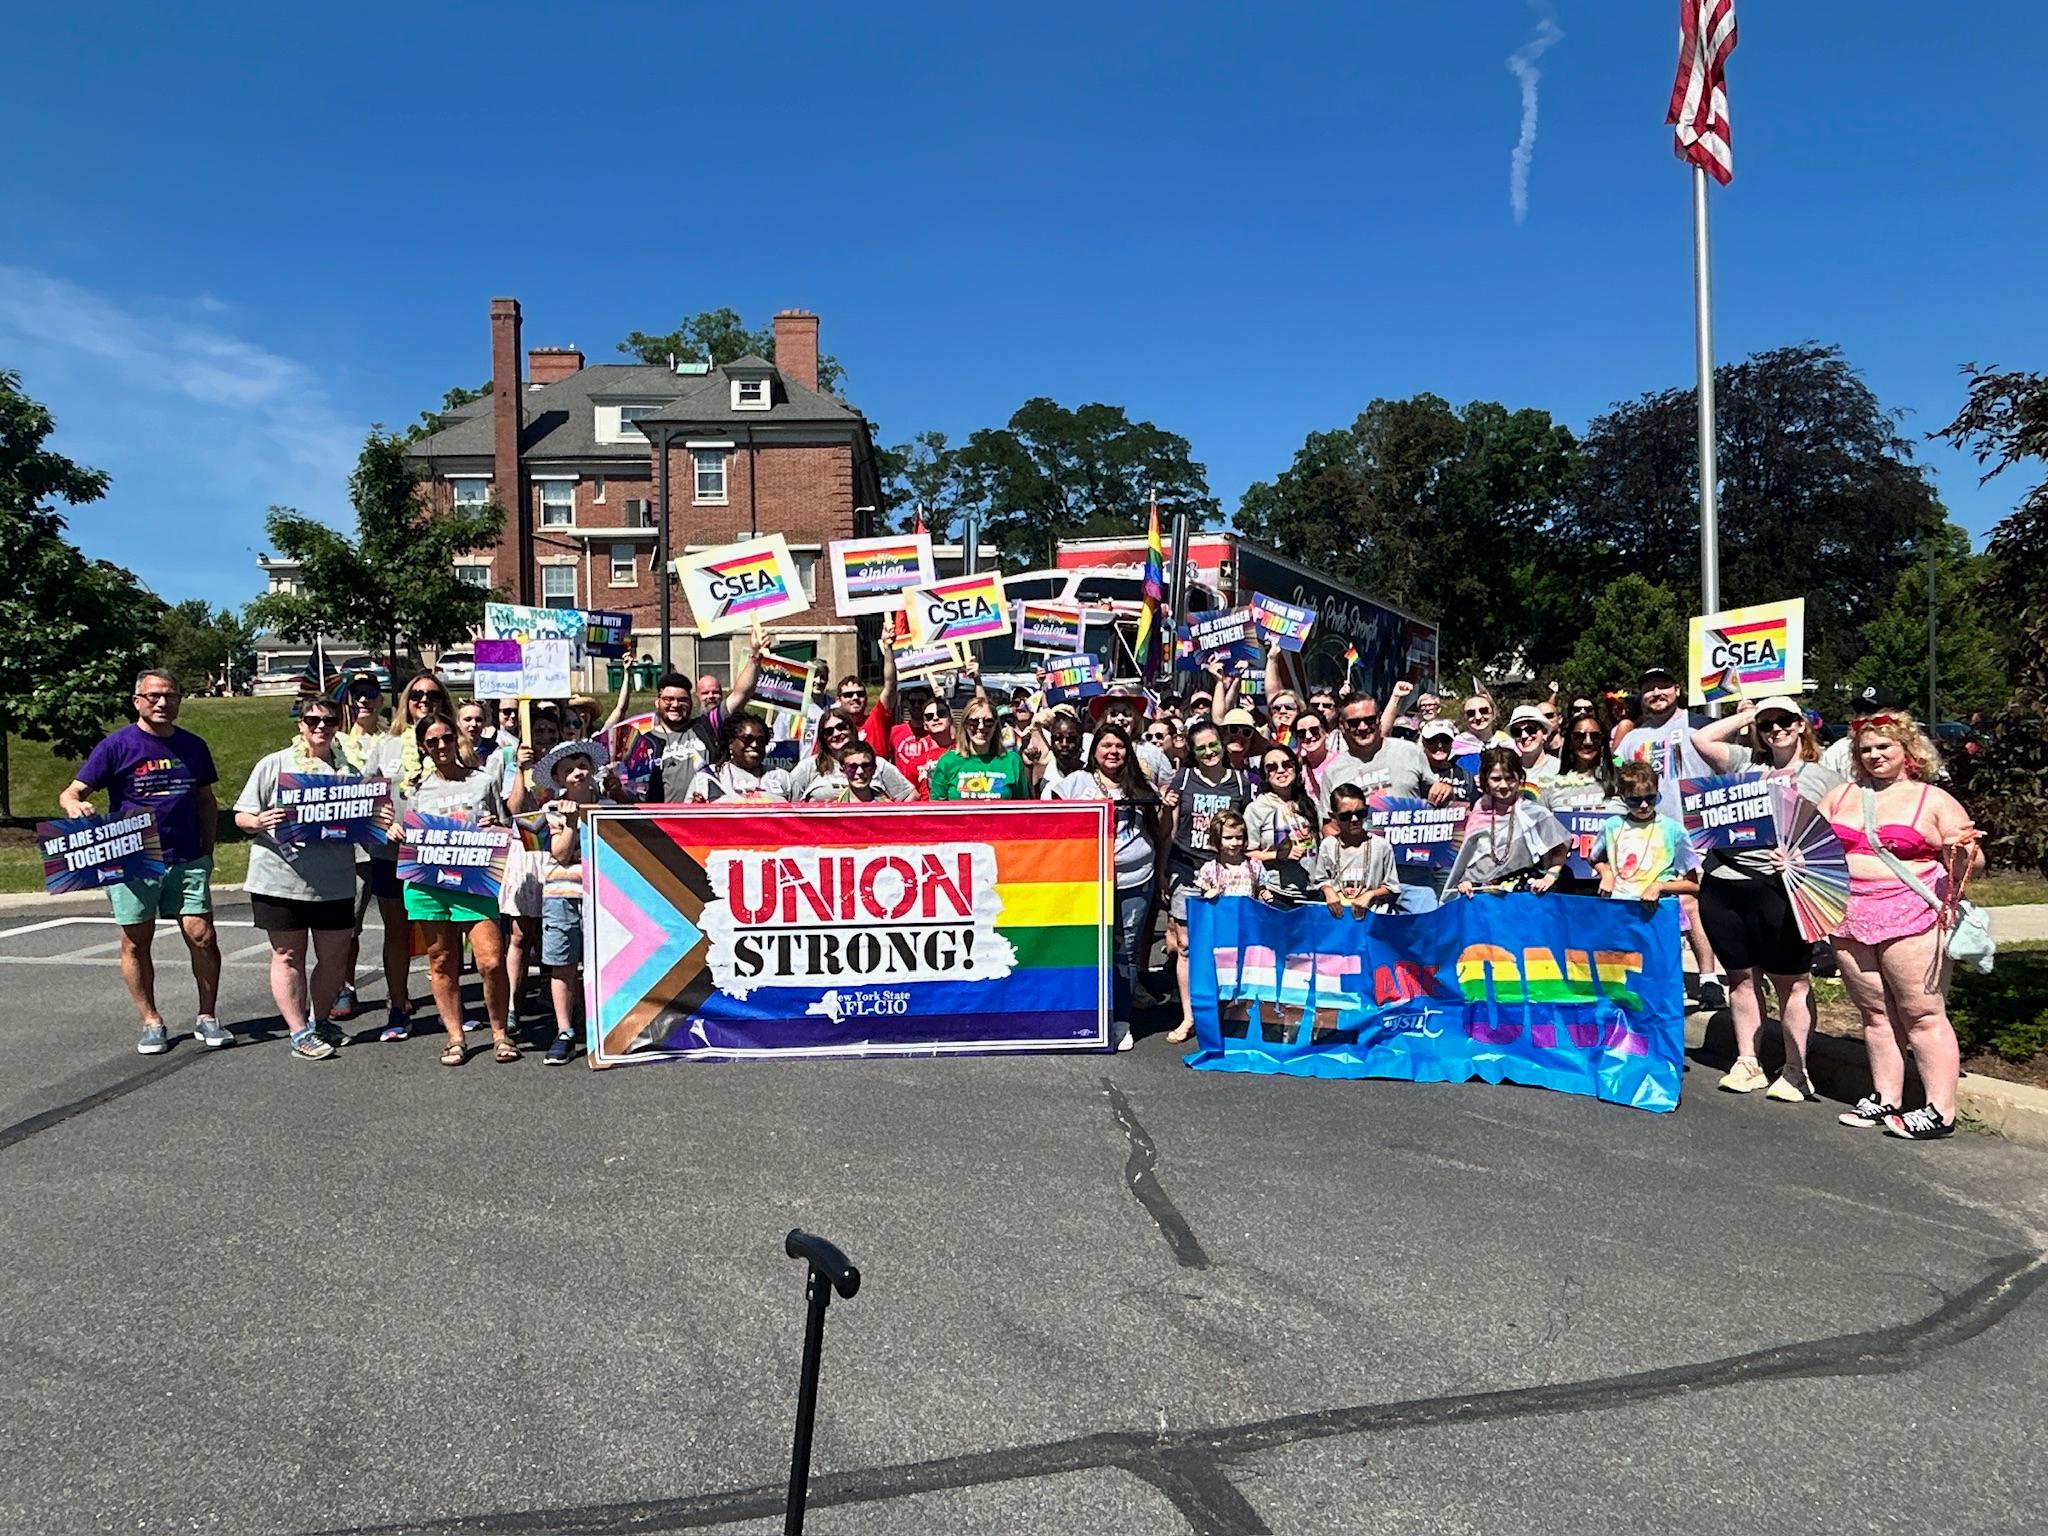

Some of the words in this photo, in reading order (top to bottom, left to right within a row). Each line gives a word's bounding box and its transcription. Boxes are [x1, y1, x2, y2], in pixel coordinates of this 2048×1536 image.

[709, 569, 777, 601] CSEA
[859, 563, 908, 583] Union
[602, 616, 622, 627] WITH
[928, 595, 992, 625] CSEA
[1200, 621, 1213, 634] ARE
[1213, 609, 1250, 631] STRONGER
[1032, 622, 1067, 636] Union
[1199, 625, 1245, 650] TOGETHER!
[1712, 639, 1776, 668] CSEA
[757, 673, 794, 692] Union
[282, 789, 300, 805] WE
[303, 787, 327, 803] ARE
[329, 782, 387, 800] STRONGER
[1685, 795, 1704, 812] WE
[1704, 788, 1727, 806] ARE
[296, 799, 374, 824] TOGETHER!
[1372, 812, 1387, 826] WE
[1390, 809, 1412, 824] ARE
[1413, 807, 1466, 824] STRONGER
[44, 836, 66, 856] WE
[68, 829, 94, 850] ARE
[95, 812, 152, 841] STRONGER
[1384, 823, 1454, 845] TOGETHER!
[1571, 817, 1576, 831] I
[406, 829, 423, 844] WE
[426, 829, 449, 846] ARE
[450, 829, 508, 848] STRONGER
[64, 832, 144, 872] TOGETHER!
[416, 846, 493, 867] TOGETHER!
[728, 853, 973, 924] UNION
[734, 929, 975, 977] STRONG!
[855, 991, 880, 1001] York
[883, 990, 911, 1000] State
[1213, 945, 1362, 1047] WE
[1373, 960, 1441, 1006] ARE
[1456, 943, 1649, 1057] ONE
